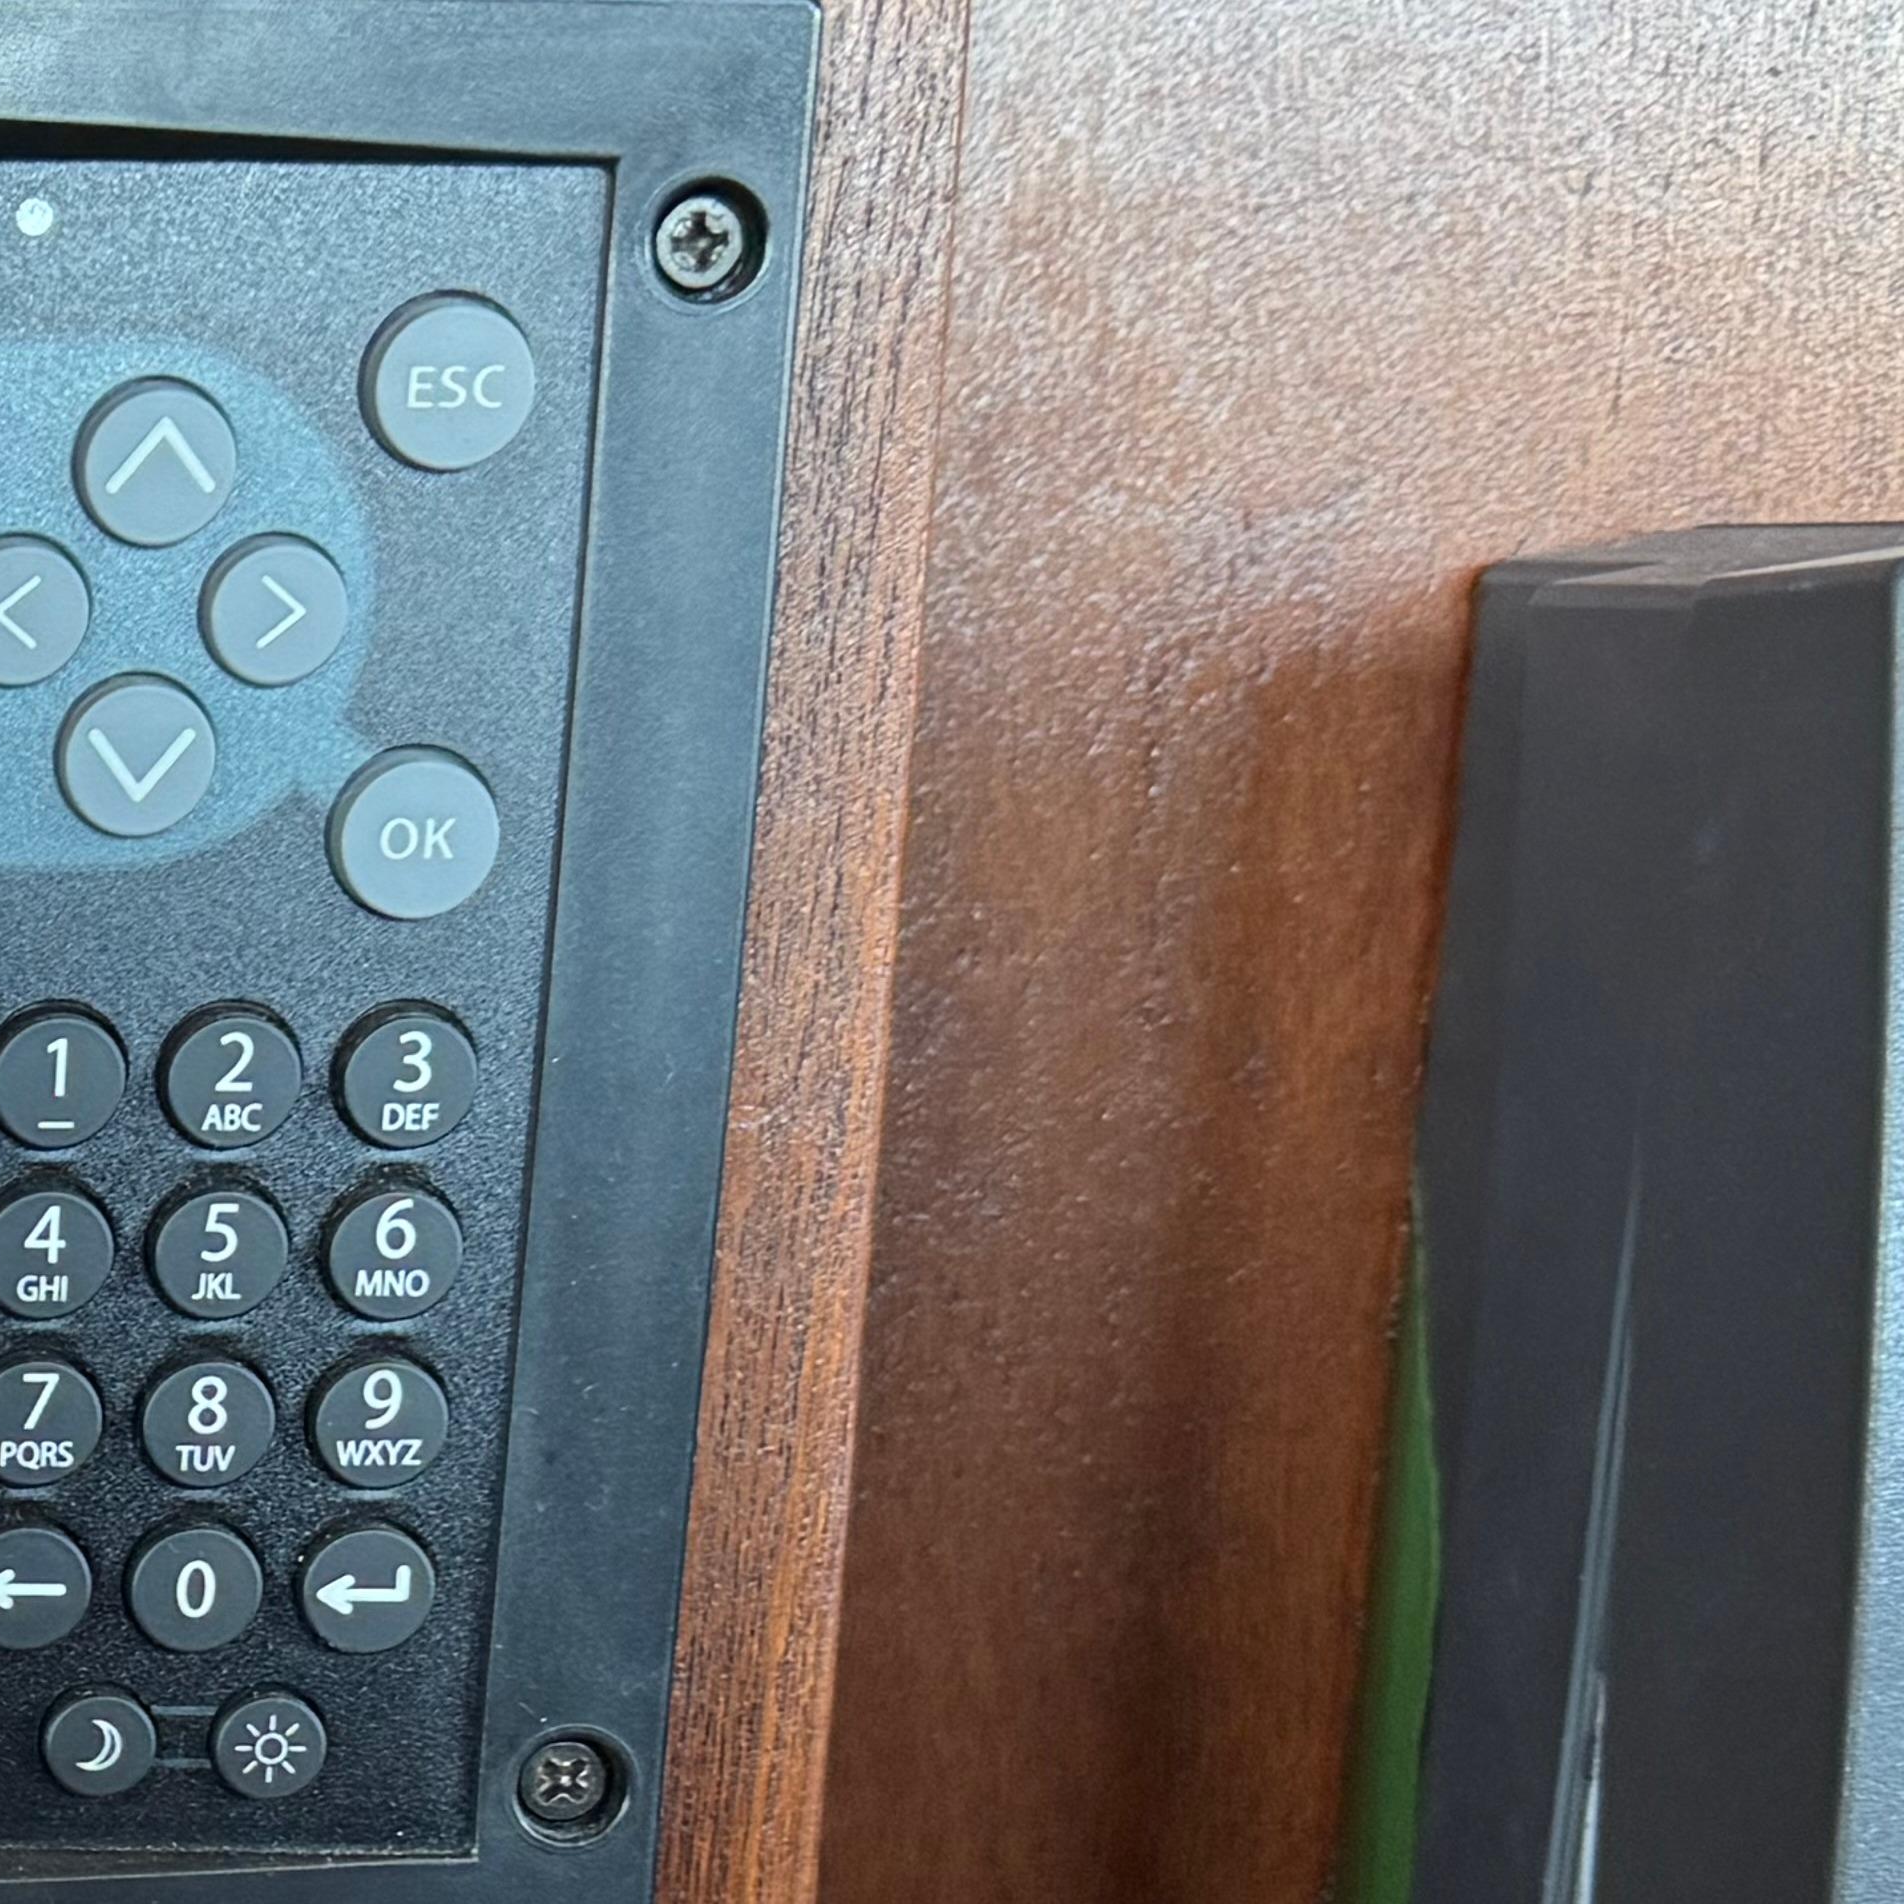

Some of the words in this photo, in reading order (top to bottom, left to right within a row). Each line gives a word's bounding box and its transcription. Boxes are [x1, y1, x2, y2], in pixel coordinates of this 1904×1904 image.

[406, 364, 505, 408] ESC
[379, 817, 456, 861] OK
[47, 1038, 70, 1098] 1
[214, 1032, 254, 1093] 2
[393, 1030, 433, 1093] 3
[201, 1103, 263, 1132] ABC
[382, 1103, 440, 1131] DEF
[23, 1205, 67, 1264] 4
[200, 1203, 241, 1262] 5
[375, 1199, 417, 1260] 6
[16, 1275, 69, 1303] GHI
[191, 1273, 242, 1301] JKL
[355, 1269, 430, 1298] MNO
[22, 1373, 60, 1430] 7
[187, 1376, 228, 1435] 8
[362, 1369, 403, 1430] 9
[0, 1440, 74, 1470] PQRS
[176, 1445, 236, 1472] TUV
[336, 1438, 423, 1467] WXYZ
[176, 1559, 216, 1618] 0
